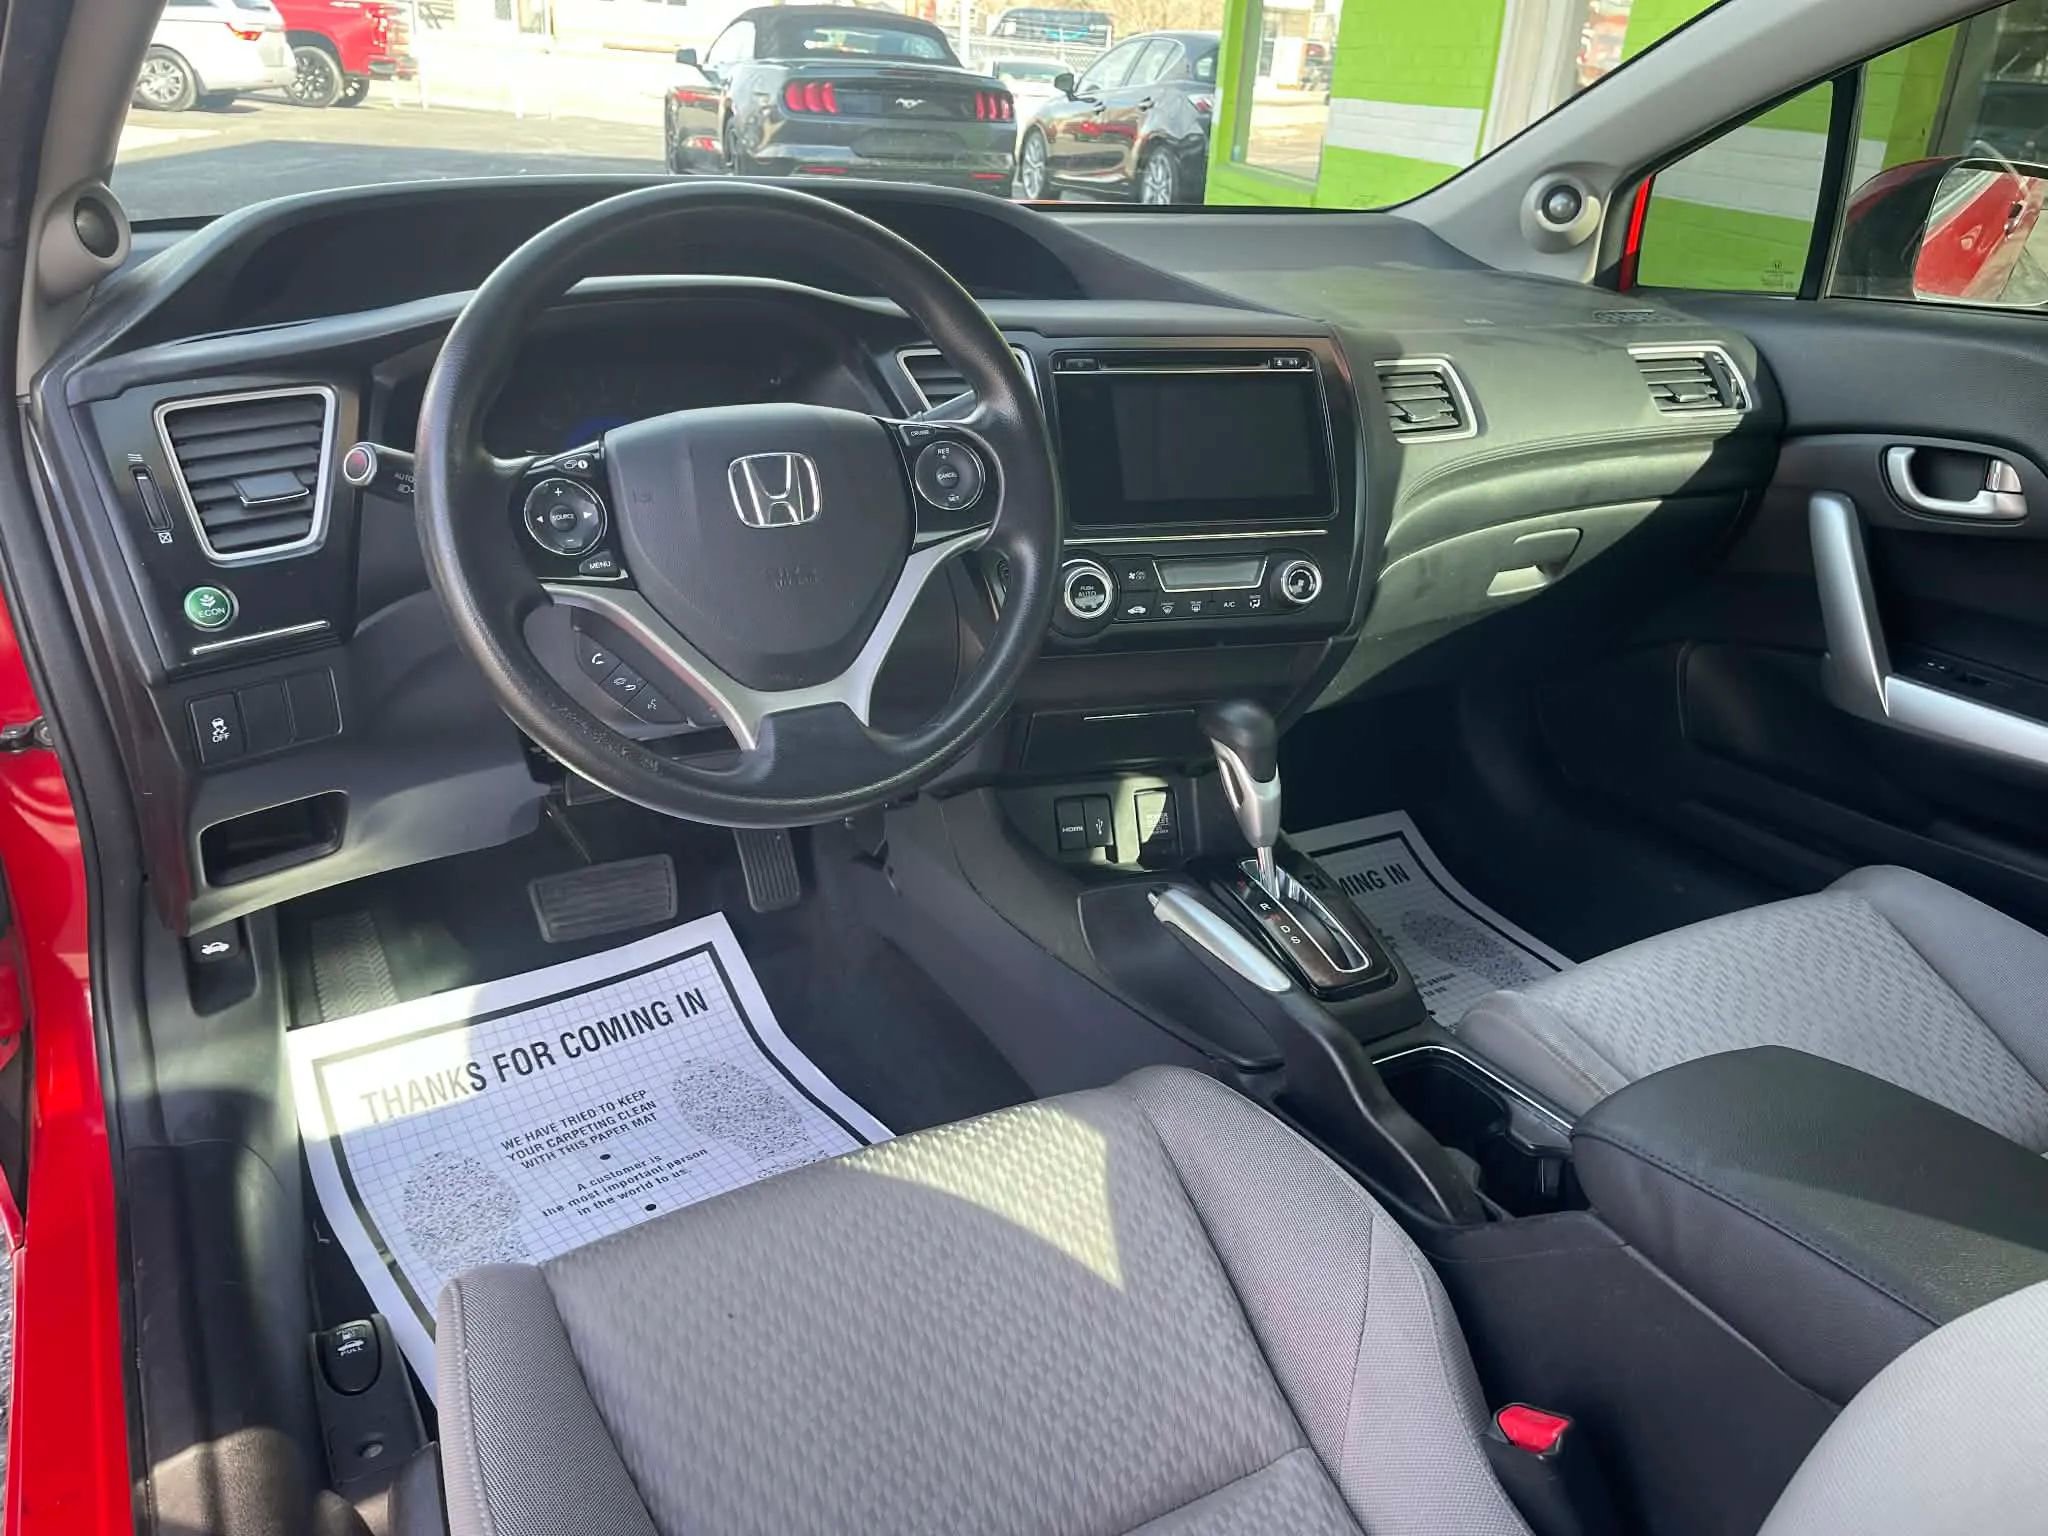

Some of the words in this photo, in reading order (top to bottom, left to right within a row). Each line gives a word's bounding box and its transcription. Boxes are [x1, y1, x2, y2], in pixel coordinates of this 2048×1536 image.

[552, 513, 575, 521] SOURCE
[589, 560, 611, 570] MENU
[198, 607, 225, 617] ECON
[212, 732, 230, 743] OFF
[1062, 825, 1083, 833] HDMI
[1383, 863, 1410, 886] IN
[1259, 902, 1272, 910] R
[1280, 925, 1291, 933] D
[1290, 936, 1301, 944] S
[360, 1061, 487, 1124] THANKS
[492, 1041, 556, 1083] FOR
[559, 1001, 674, 1059] COMING
[680, 987, 709, 1018] IN
[501, 1136, 523, 1151] WE
[525, 1122, 558, 1142] HAVE
[560, 1109, 597, 1128] TRIED
[598, 1101, 616, 1114] TO
[617, 1089, 647, 1107] KEEP
[505, 1143, 544, 1161] YOUR
[546, 1116, 616, 1148] CARPETING
[617, 1100, 656, 1121] CLEAN
[521, 1151, 557, 1169] WITH
[558, 1140, 588, 1156] THIS
[590, 1123, 630, 1144] PAPER
[631, 1112, 657, 1128] MAT
[577, 1183, 587, 1192] A
[589, 1160, 647, 1186] customer
[648, 1155, 662, 1164] is
[542, 1205, 565, 1217] the
[568, 1190, 600, 1207] most
[602, 1165, 664, 1193] important
[666, 1148, 708, 1170] person
[576, 1206, 591, 1216] in
[593, 1197, 616, 1209] the
[617, 1181, 654, 1200] world
[655, 1176, 669, 1184] to
